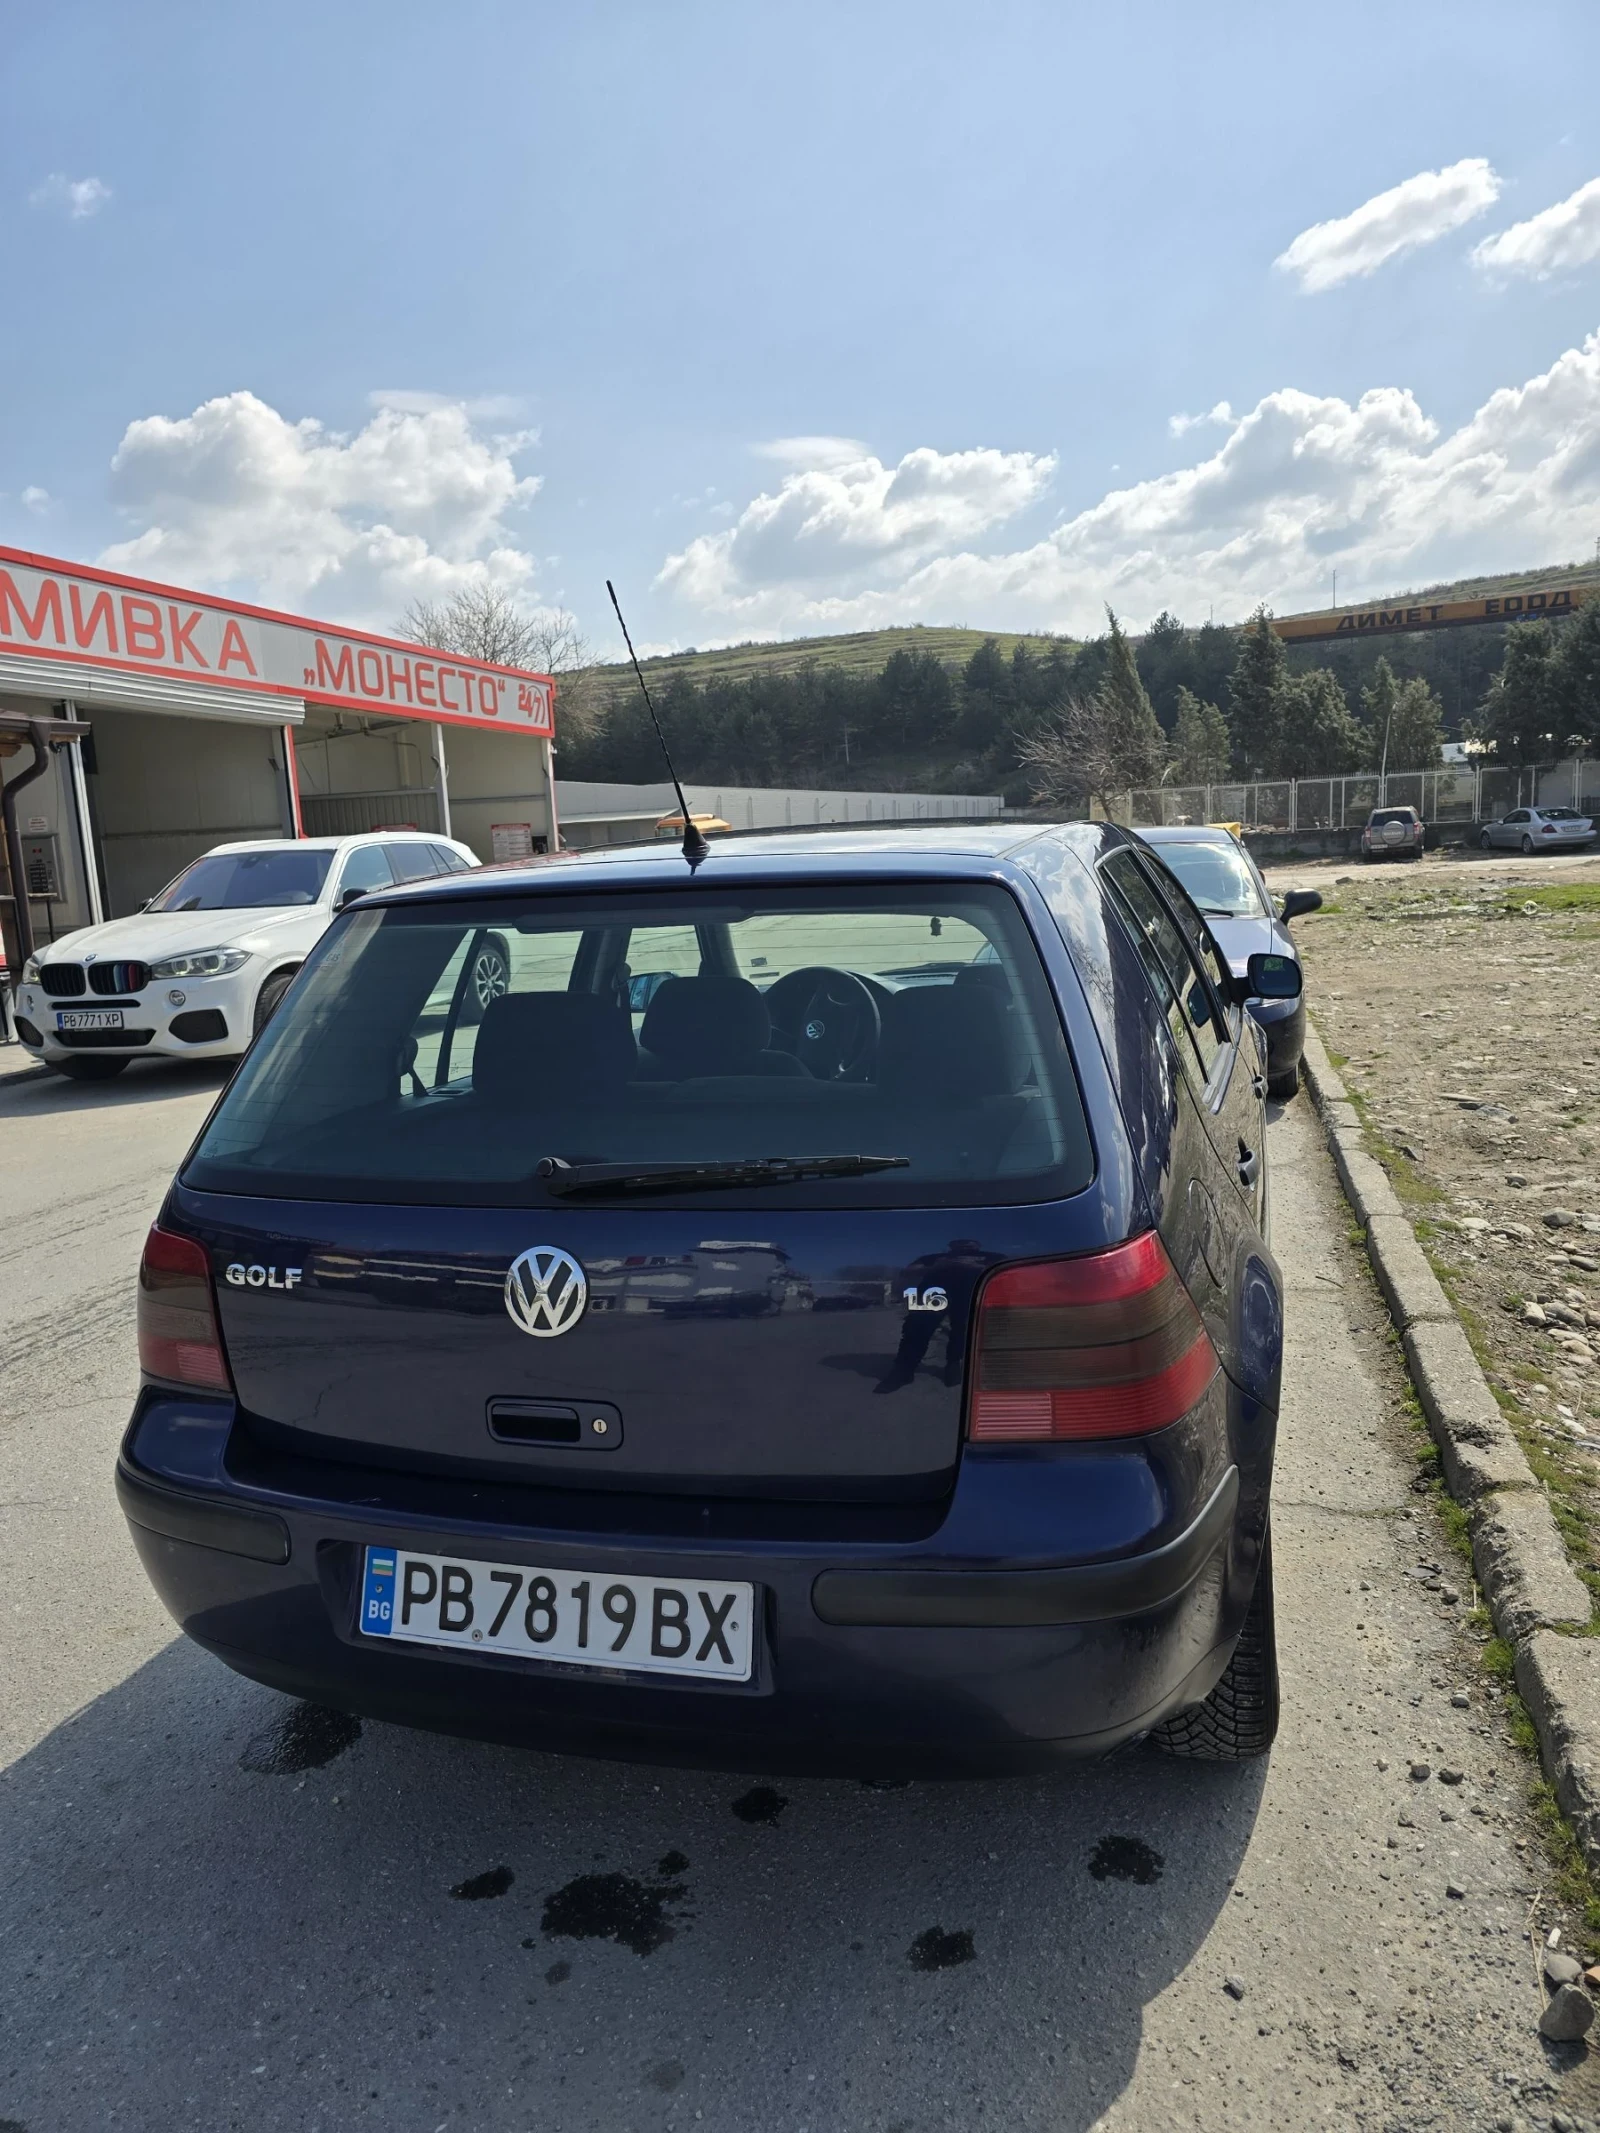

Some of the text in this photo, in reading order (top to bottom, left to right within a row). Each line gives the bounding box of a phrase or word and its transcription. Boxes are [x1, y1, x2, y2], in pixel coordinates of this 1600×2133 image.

[1336, 591, 1571, 631] ДИМЕТ ЕООД
[0, 568, 257, 676] МИВКА
[518, 684, 544, 724] 24/7
[225, 1263, 303, 1289] GOLF
[367, 1599, 391, 1621] BG
[401, 1561, 737, 1665] PB 7819 BX
